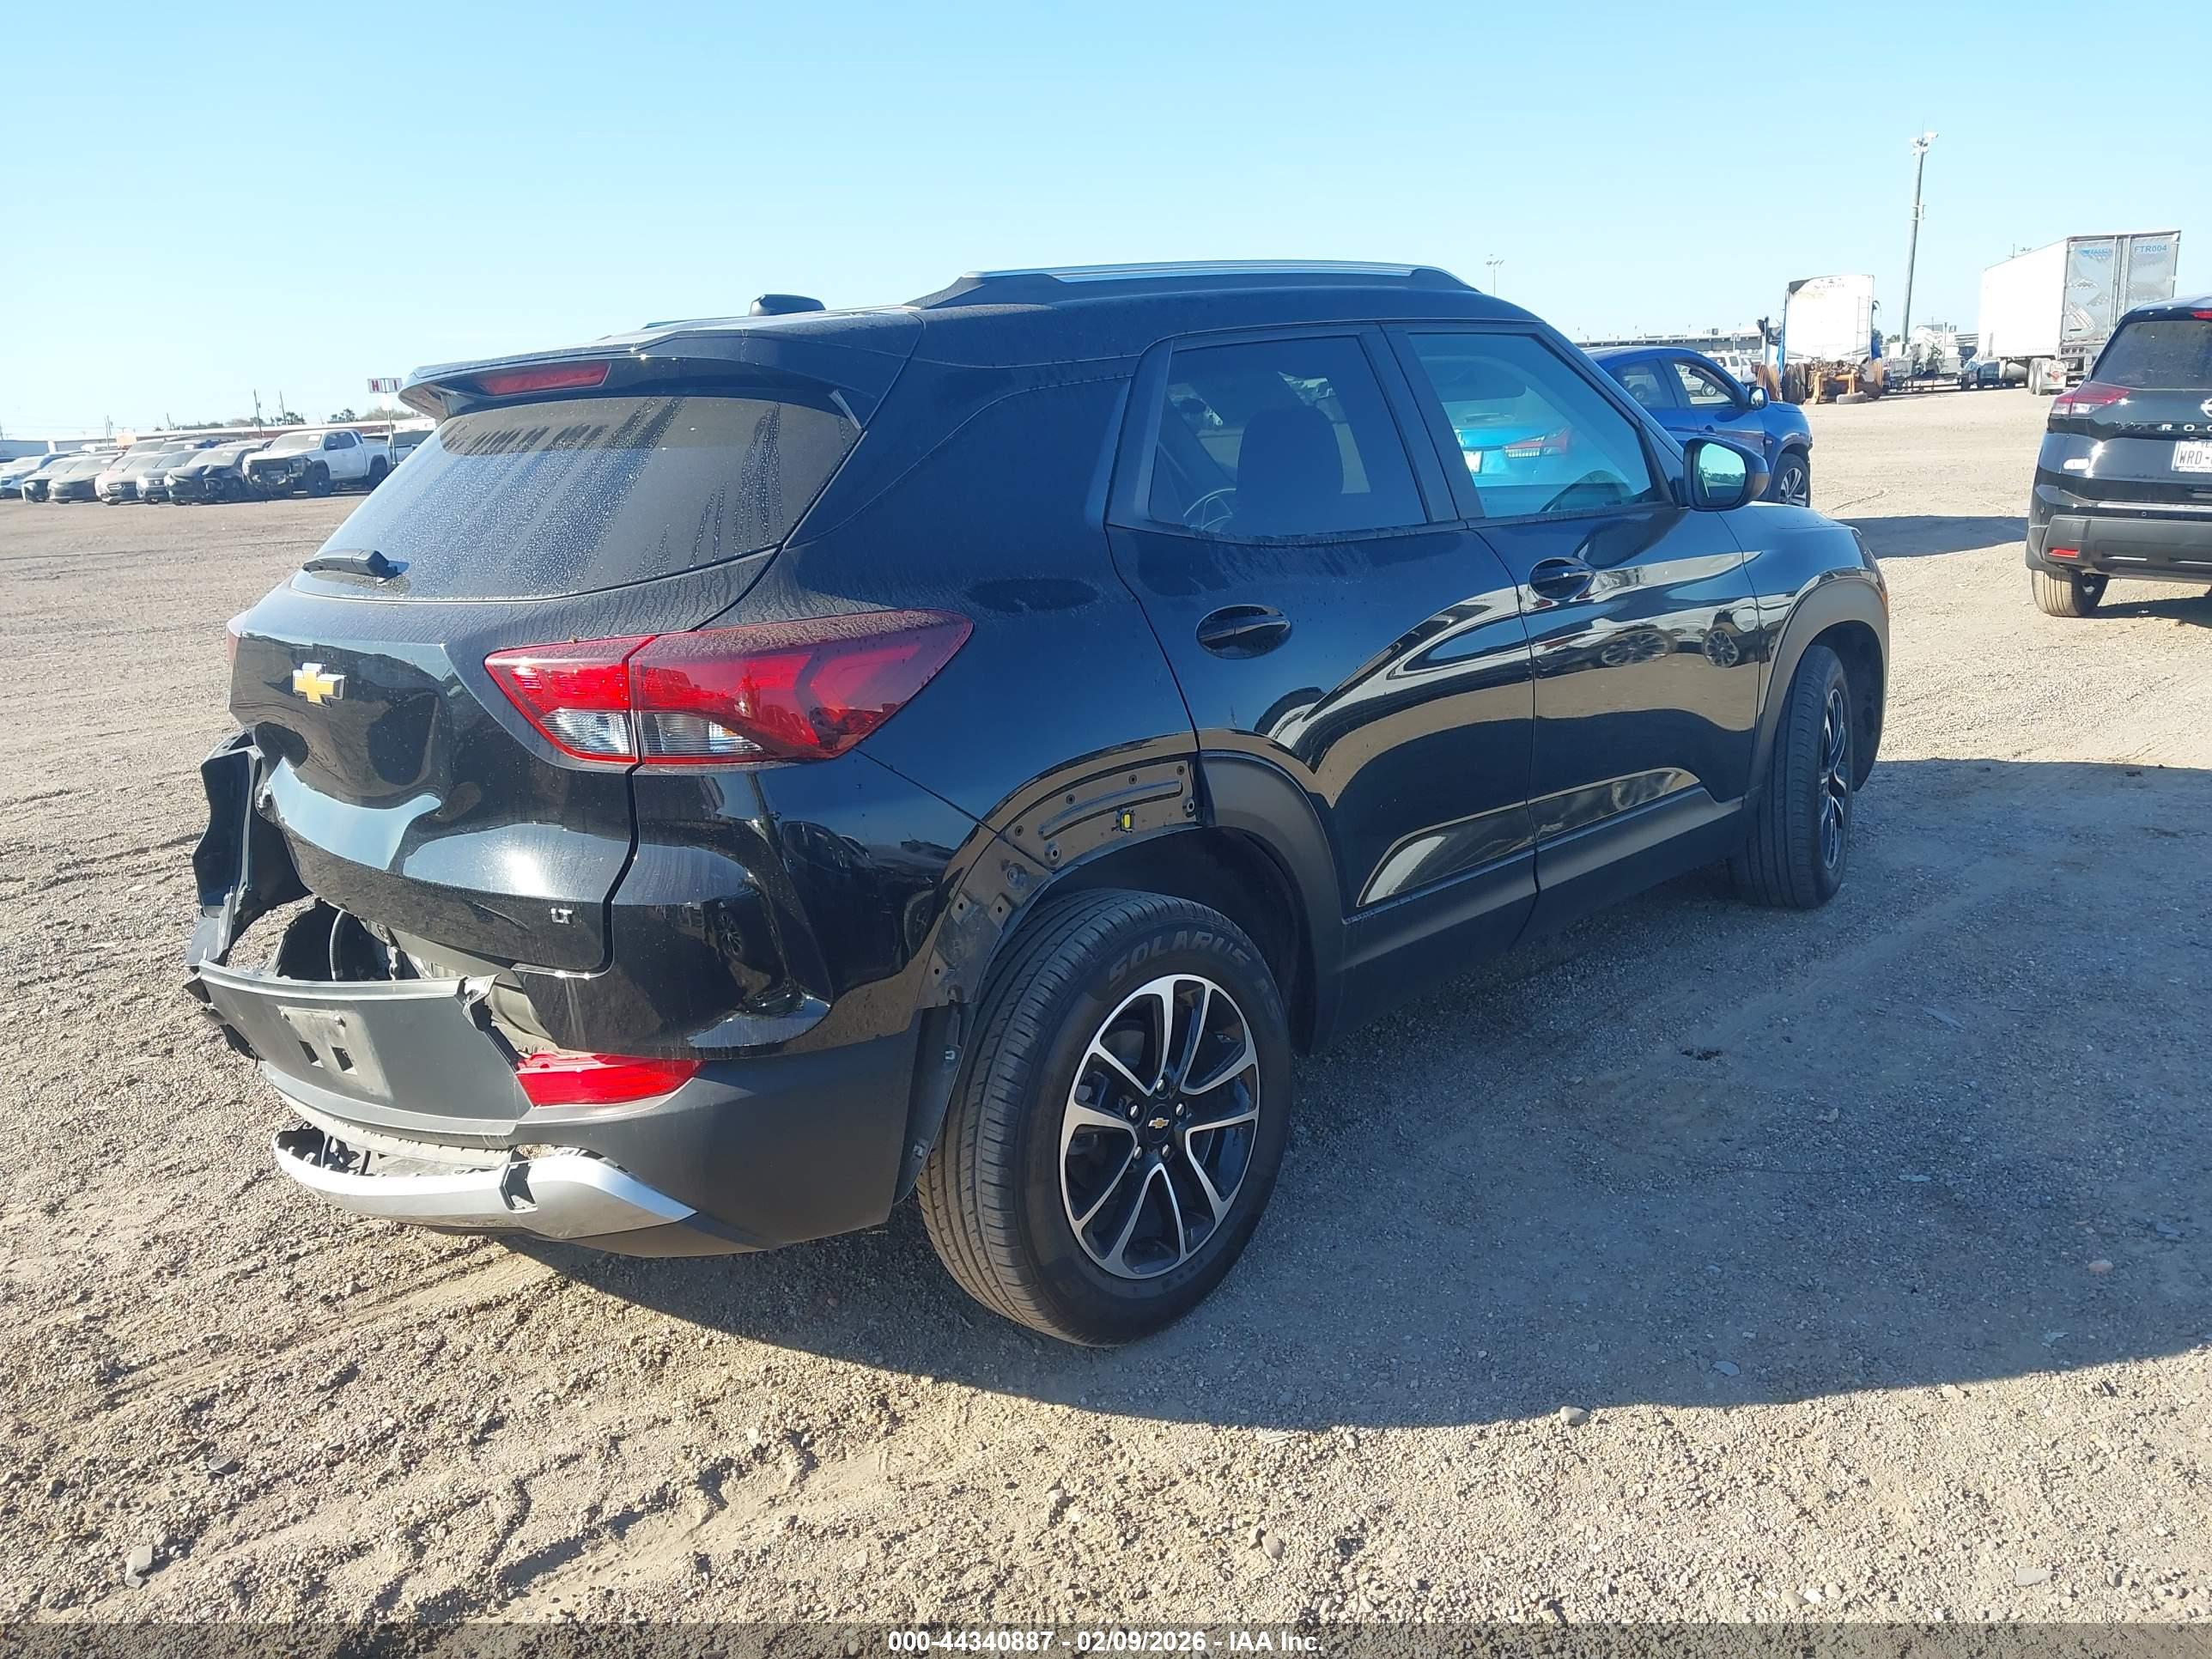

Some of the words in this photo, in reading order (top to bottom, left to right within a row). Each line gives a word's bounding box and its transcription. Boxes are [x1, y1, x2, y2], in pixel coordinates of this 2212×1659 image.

[2134, 245, 2167, 254] FTR004
[2179, 450, 2212, 465] WRD-
[550, 908, 573, 925] LT
[1109, 930, 1251, 981] SOLARUS
